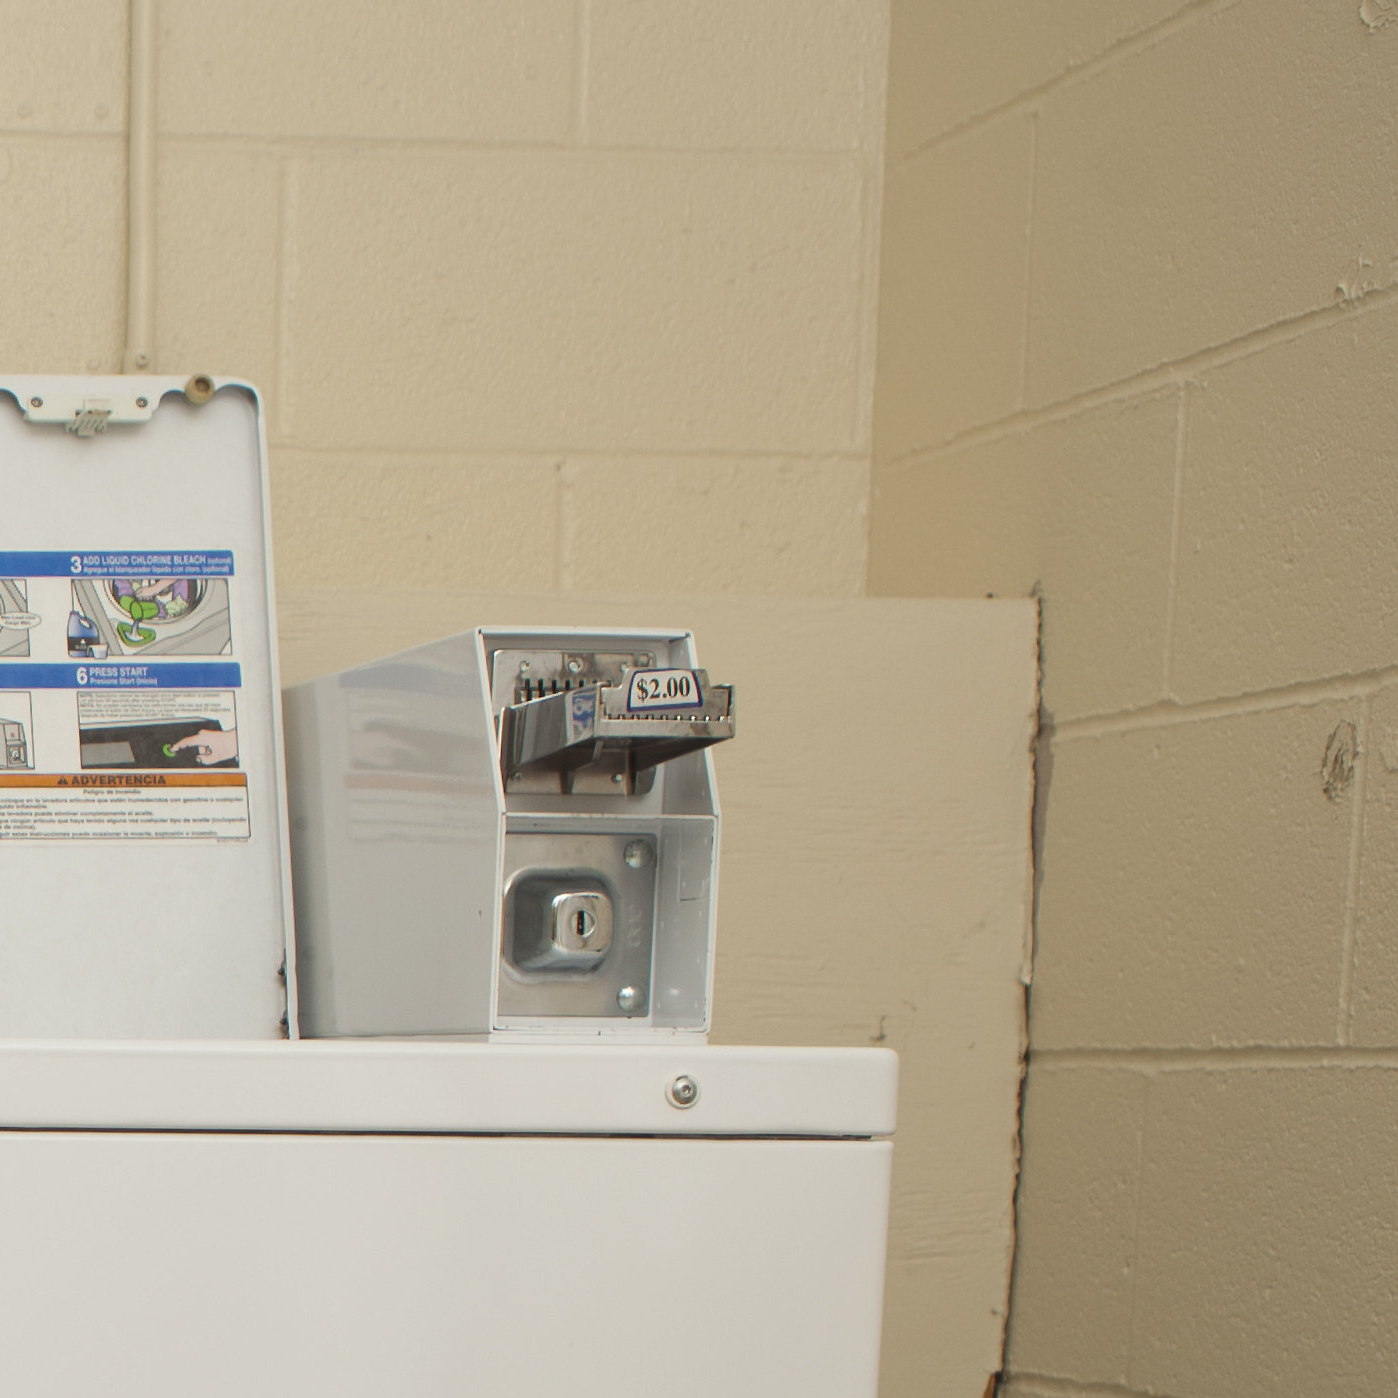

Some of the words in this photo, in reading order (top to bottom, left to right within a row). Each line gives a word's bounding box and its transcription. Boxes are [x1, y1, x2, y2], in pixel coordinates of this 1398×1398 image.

[71, 556, 82, 573] 3
[83, 556, 99, 564] ADD
[102, 555, 129, 565] LIQUID
[131, 555, 172, 564] CHLORINE
[174, 555, 206, 564] BLEACH
[76, 667, 88, 685] 6
[89, 667, 118, 677] PRESS
[119, 667, 148, 676] START
[636, 676, 691, 702] $2.00
[71, 775, 167, 785] ADVERTENCIA
